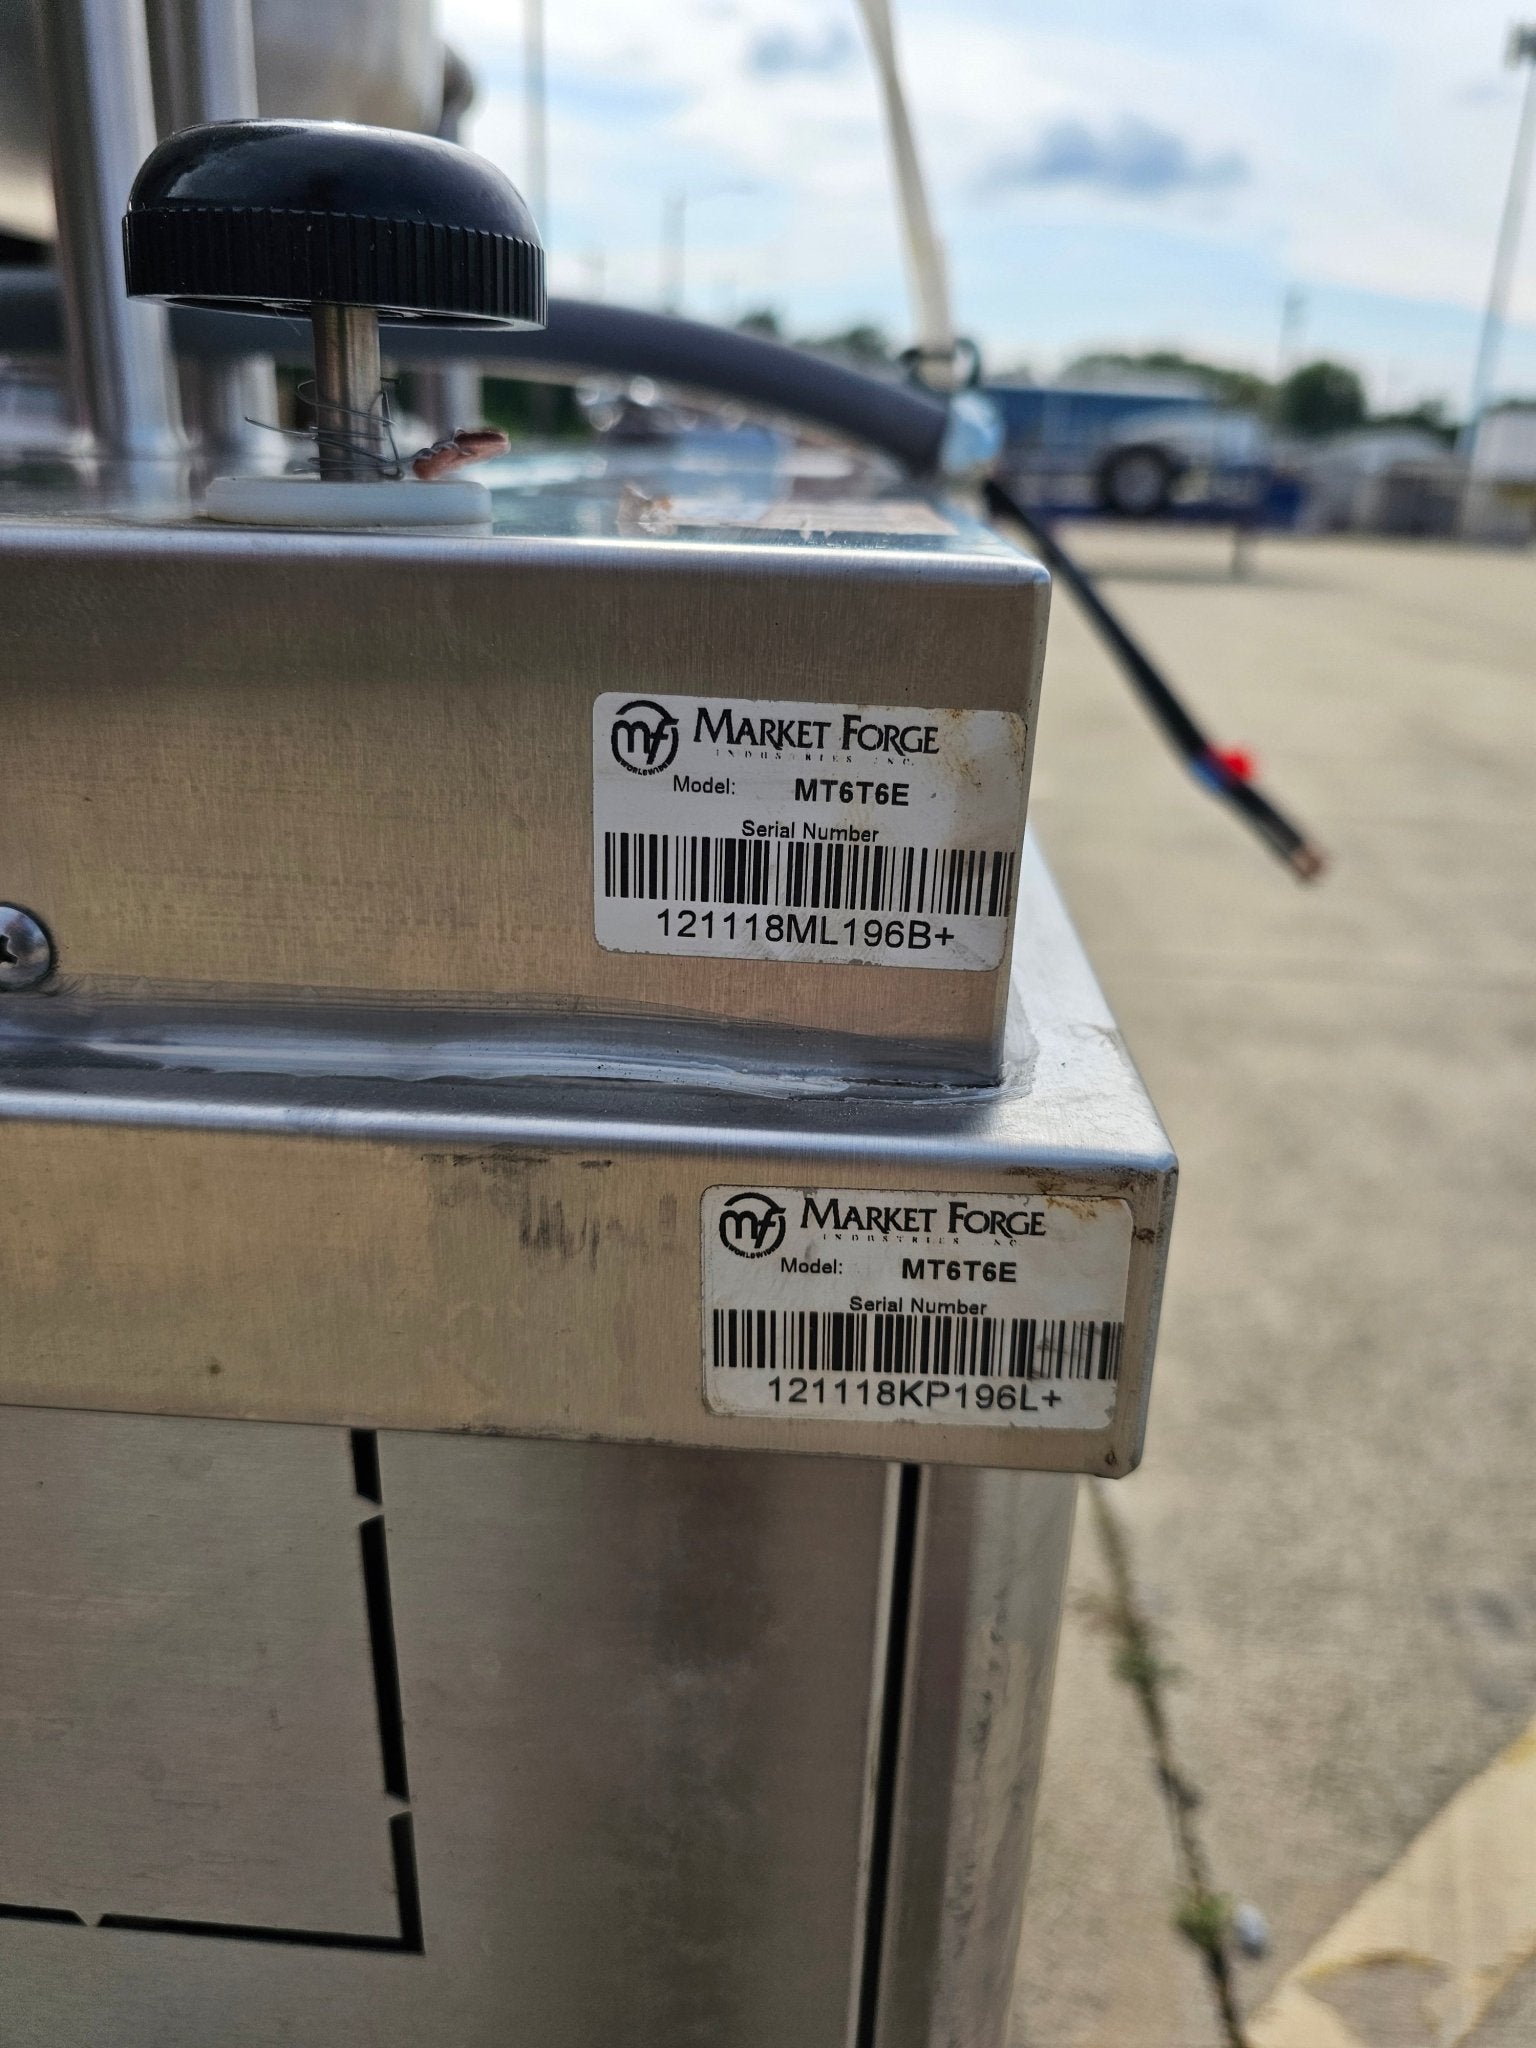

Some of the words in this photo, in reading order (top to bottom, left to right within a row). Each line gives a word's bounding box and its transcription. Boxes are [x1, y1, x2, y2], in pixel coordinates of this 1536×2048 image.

[693, 708, 832, 751] MARKET
[841, 714, 940, 756] FORGE
[716, 749, 852, 763] INDUSRIES
[673, 775, 736, 795] Model:
[794, 778, 910, 806] MT6T6E
[741, 820, 796, 839] Serial
[803, 822, 879, 843] Number
[657, 908, 955, 950] 121118ML196B+
[800, 1198, 937, 1234] MARKET
[948, 1201, 1046, 1239] FORGE
[781, 1257, 843, 1275] Model:
[901, 1258, 1017, 1283] MT6T6E
[849, 1296, 902, 1312] Serial
[910, 1298, 987, 1315] Number
[768, 1376, 1062, 1411] 121118KP196L+
